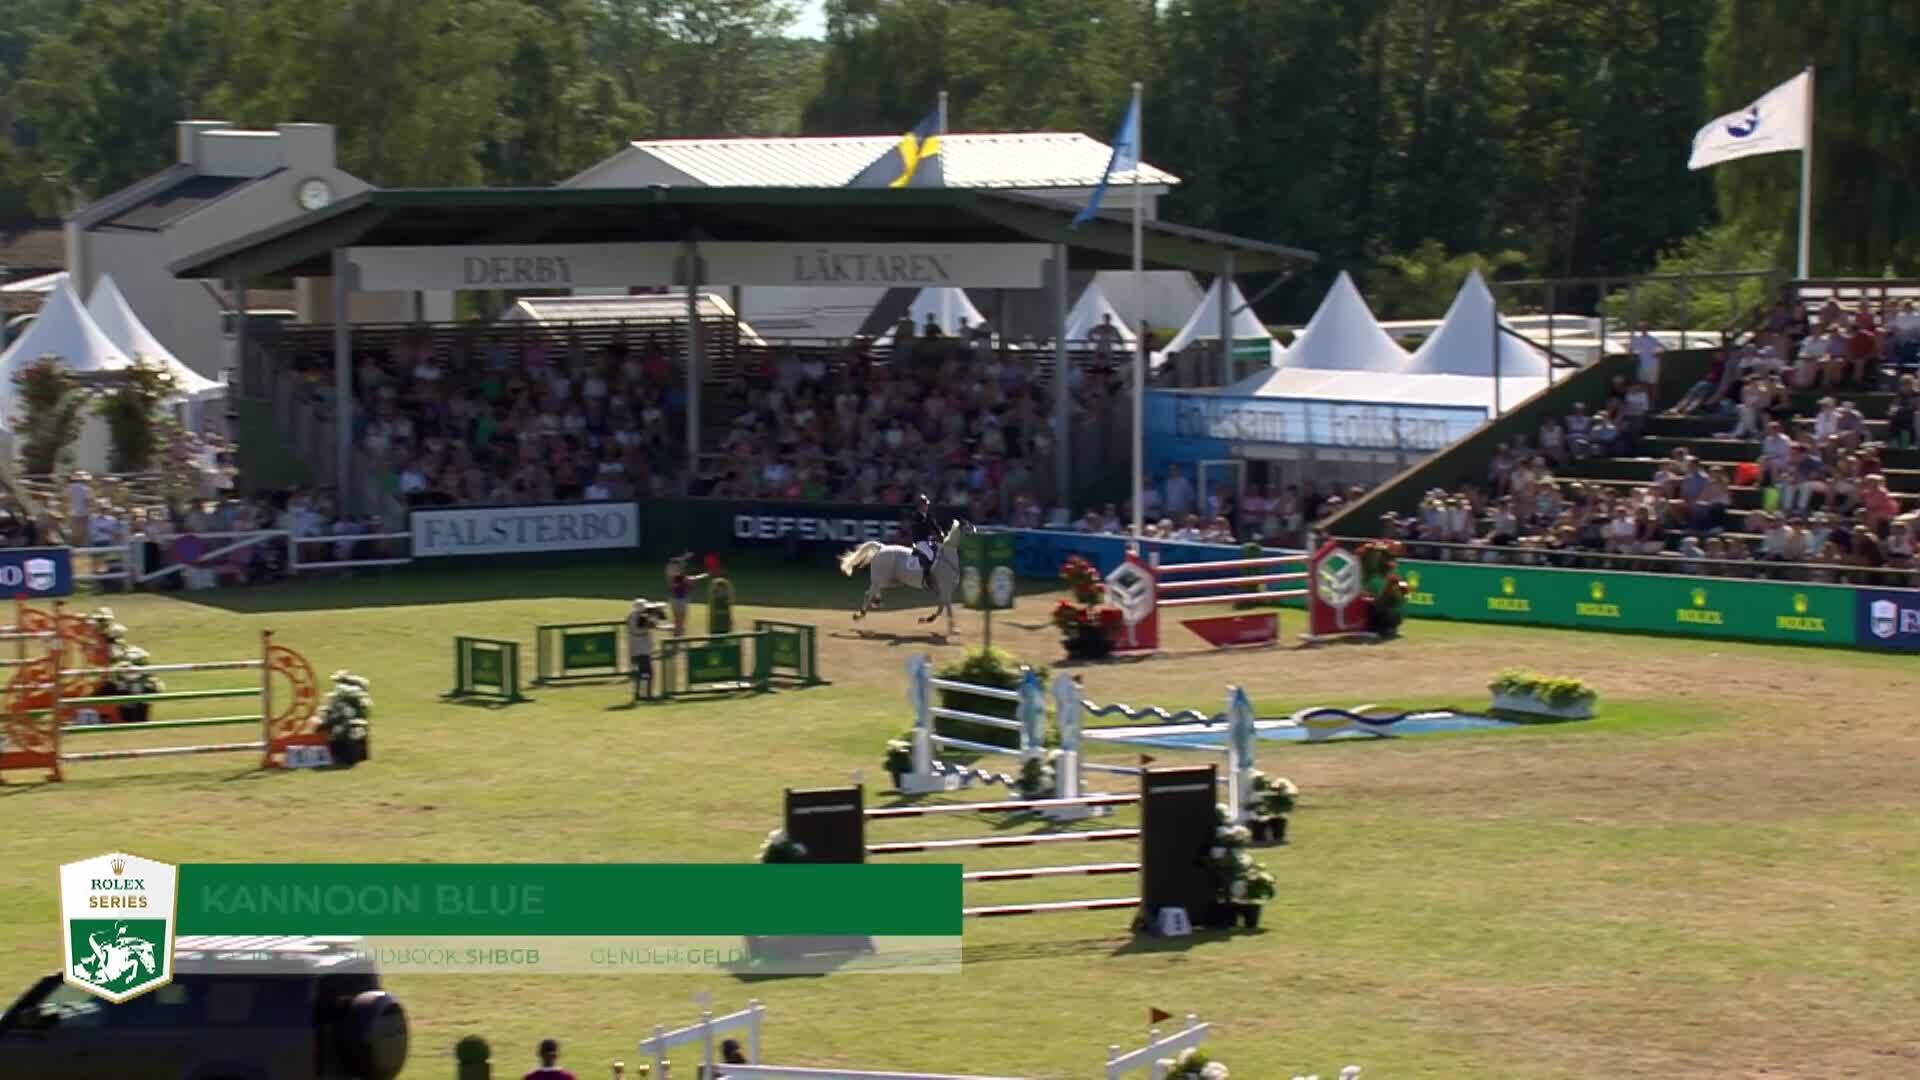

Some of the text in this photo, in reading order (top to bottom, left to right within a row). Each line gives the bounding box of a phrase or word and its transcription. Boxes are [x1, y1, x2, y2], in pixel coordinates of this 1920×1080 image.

[463, 256, 573, 285] DERBY
[795, 248, 950, 282] LÄKTAREN
[423, 511, 628, 549] FALSTERBO
